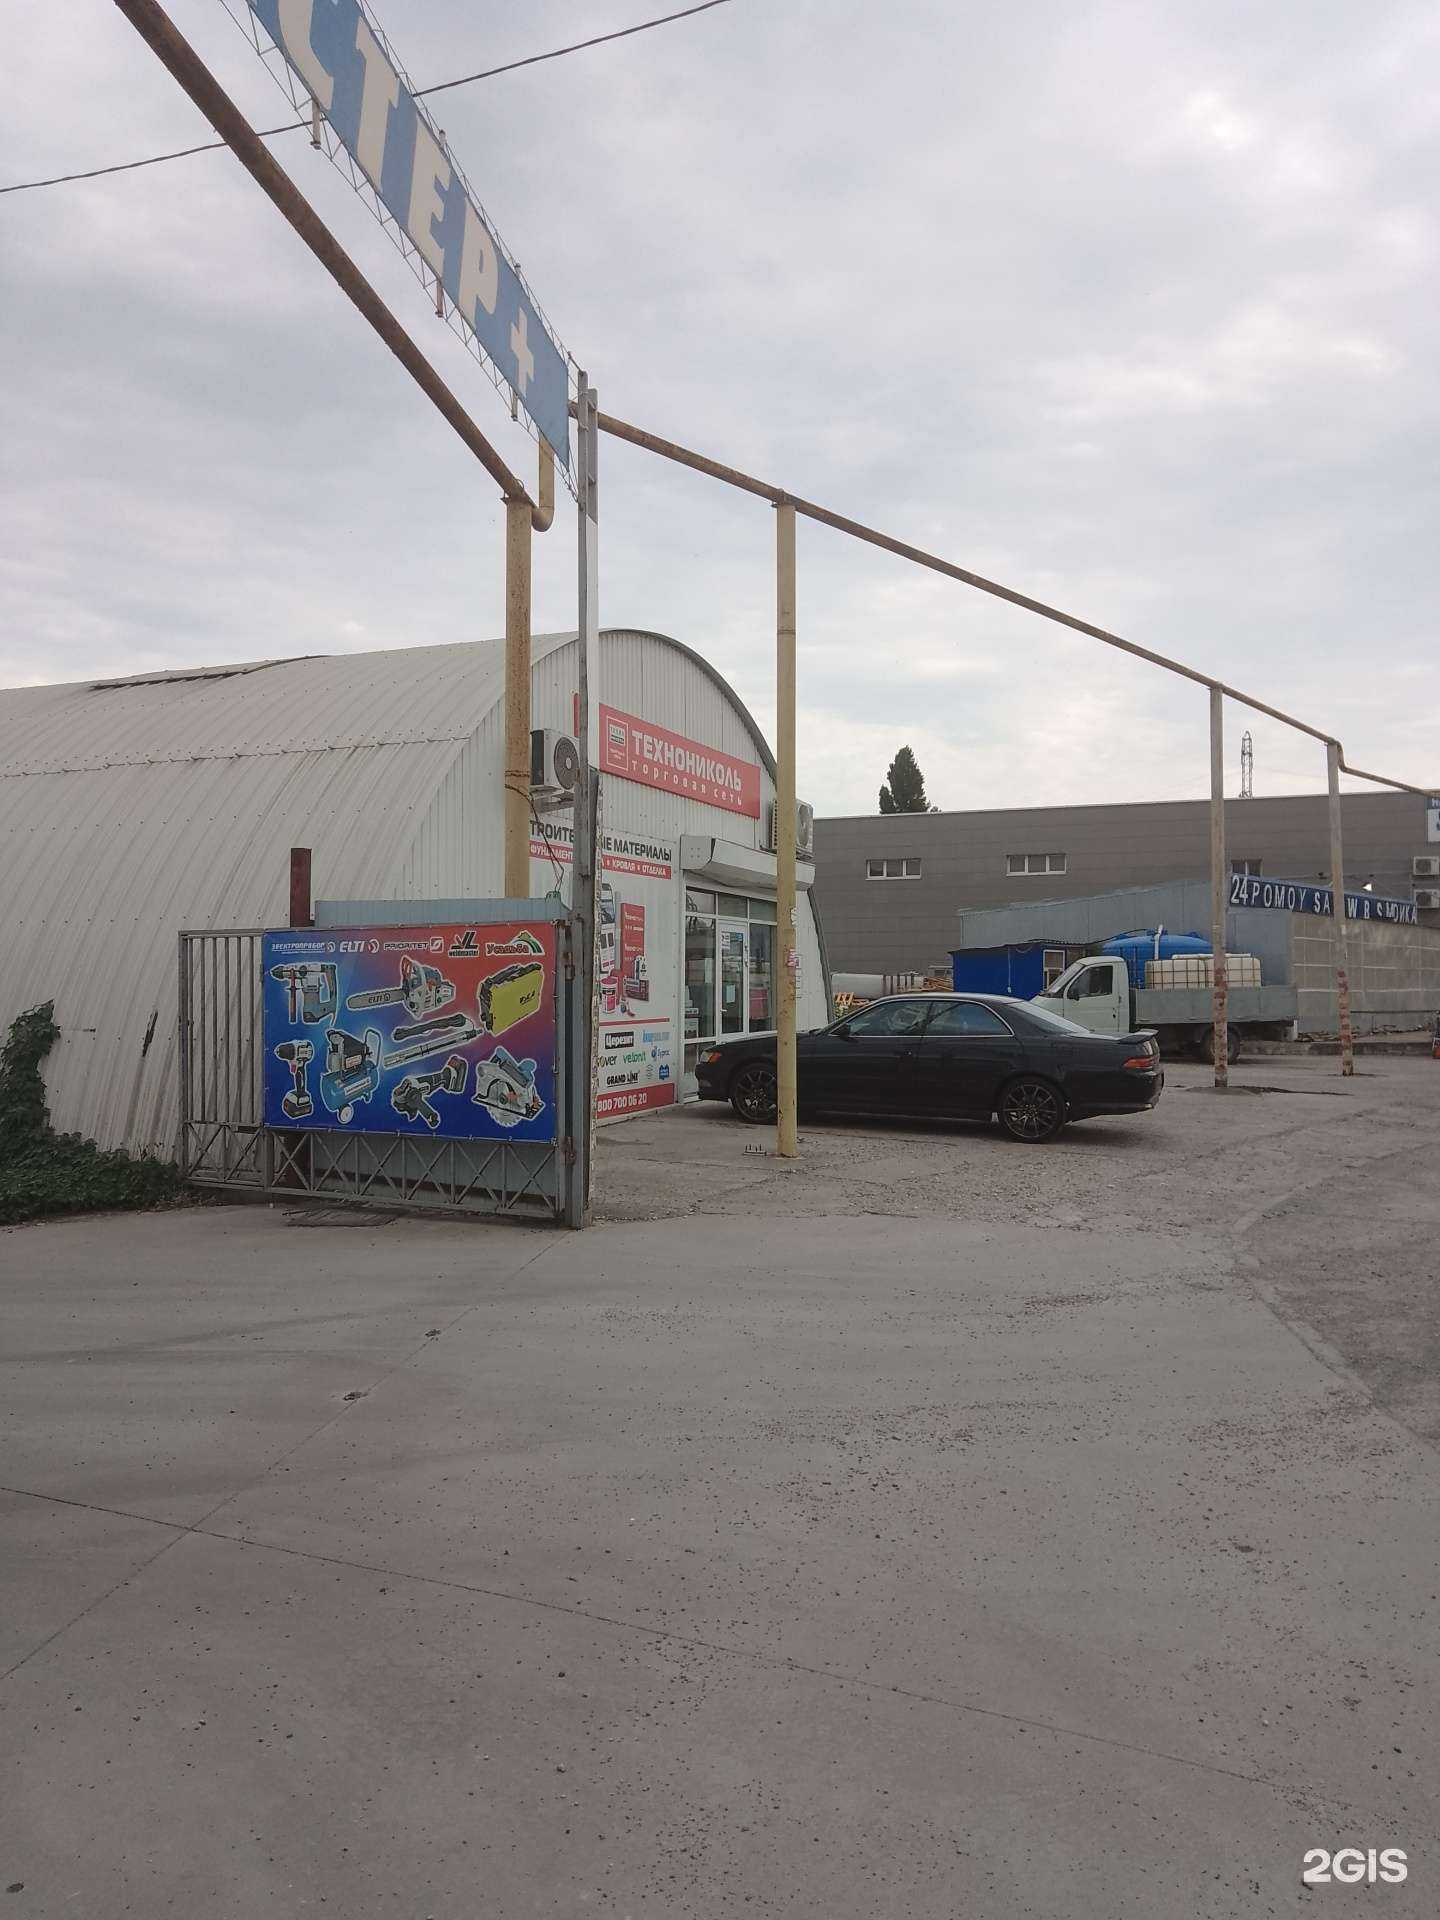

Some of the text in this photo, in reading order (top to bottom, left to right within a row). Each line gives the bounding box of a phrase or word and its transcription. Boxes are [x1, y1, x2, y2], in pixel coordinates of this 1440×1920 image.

[279, 0, 500, 332] СТЕР
[631, 730, 742, 791] ТЕХНОНИКОЛЬ
[613, 838, 672, 862] МАТЕРИАЛЫ
[1231, 875, 1248, 905] 24
[340, 941, 366, 952] ELTI
[607, 1074, 626, 1085] GRAND
